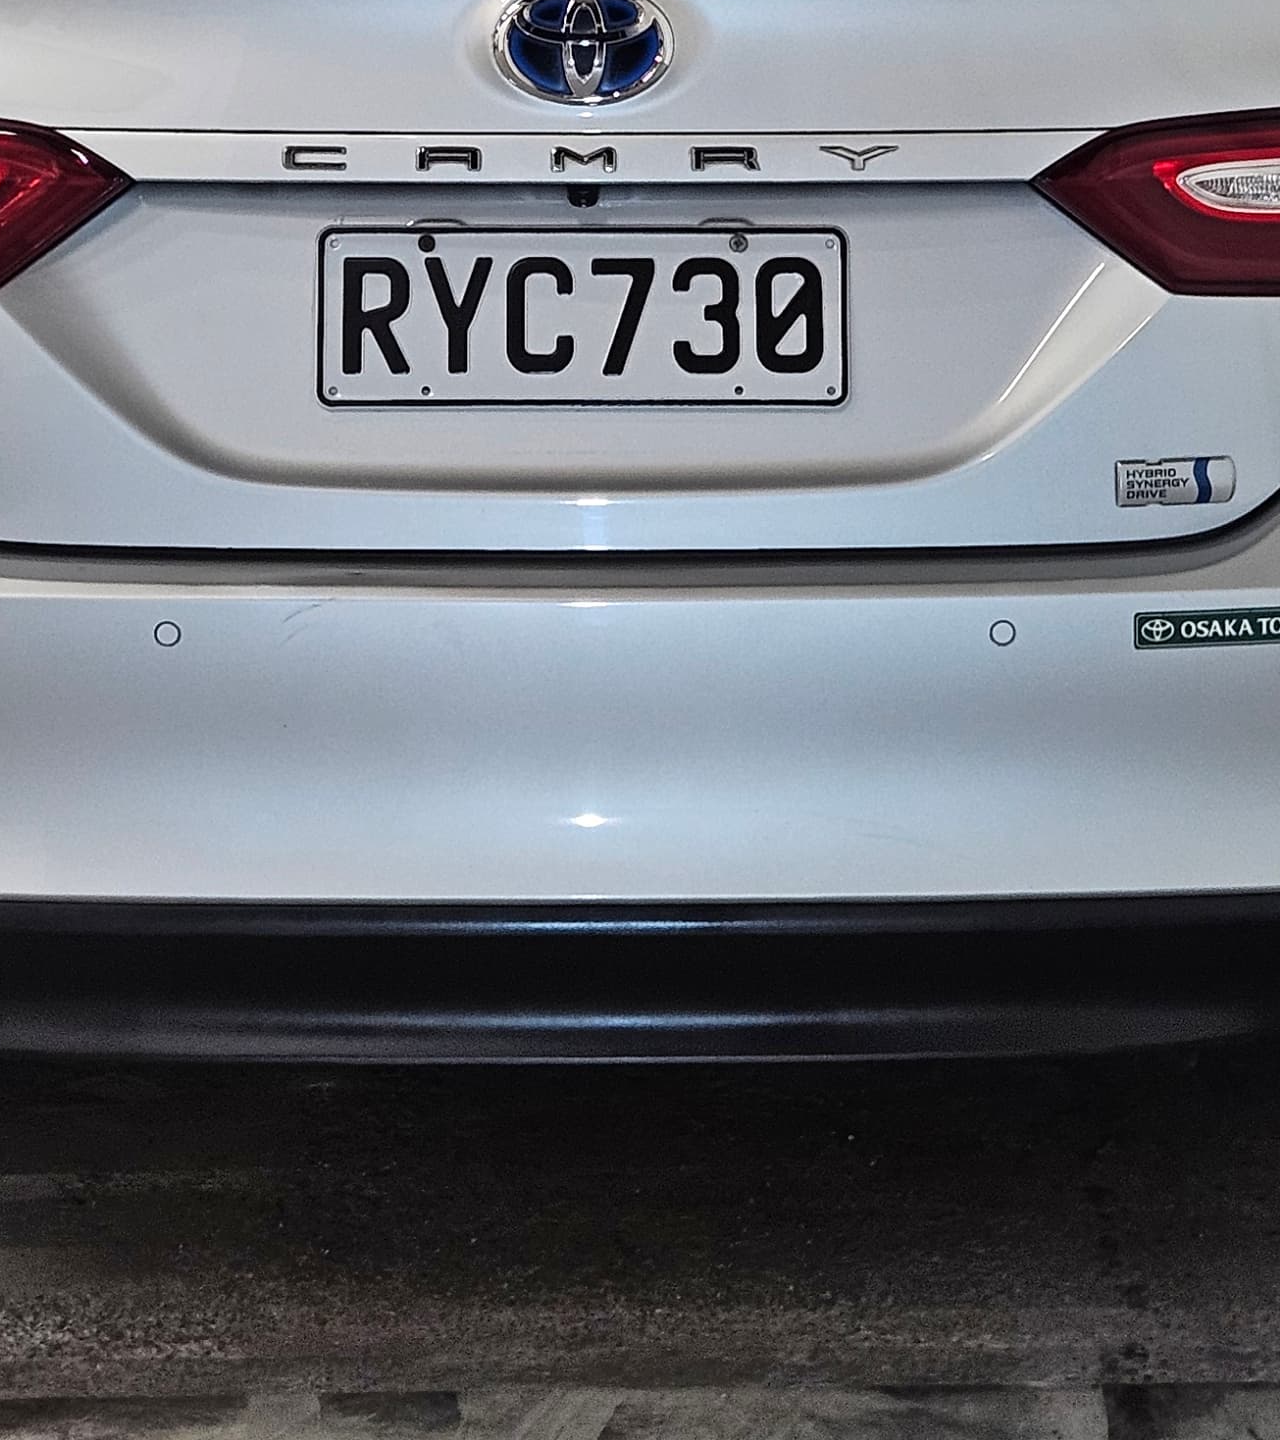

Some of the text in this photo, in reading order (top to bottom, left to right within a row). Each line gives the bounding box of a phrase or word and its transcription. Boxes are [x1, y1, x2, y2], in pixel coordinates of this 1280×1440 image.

[281, 144, 900, 173] CAMRY
[341, 256, 824, 376] RYC730
[1126, 468, 1177, 479] HYBRID
[1126, 478, 1190, 490] SYNERGY
[1126, 489, 1167, 500] DRIVE
[1180, 618, 1254, 639] OSAKA
